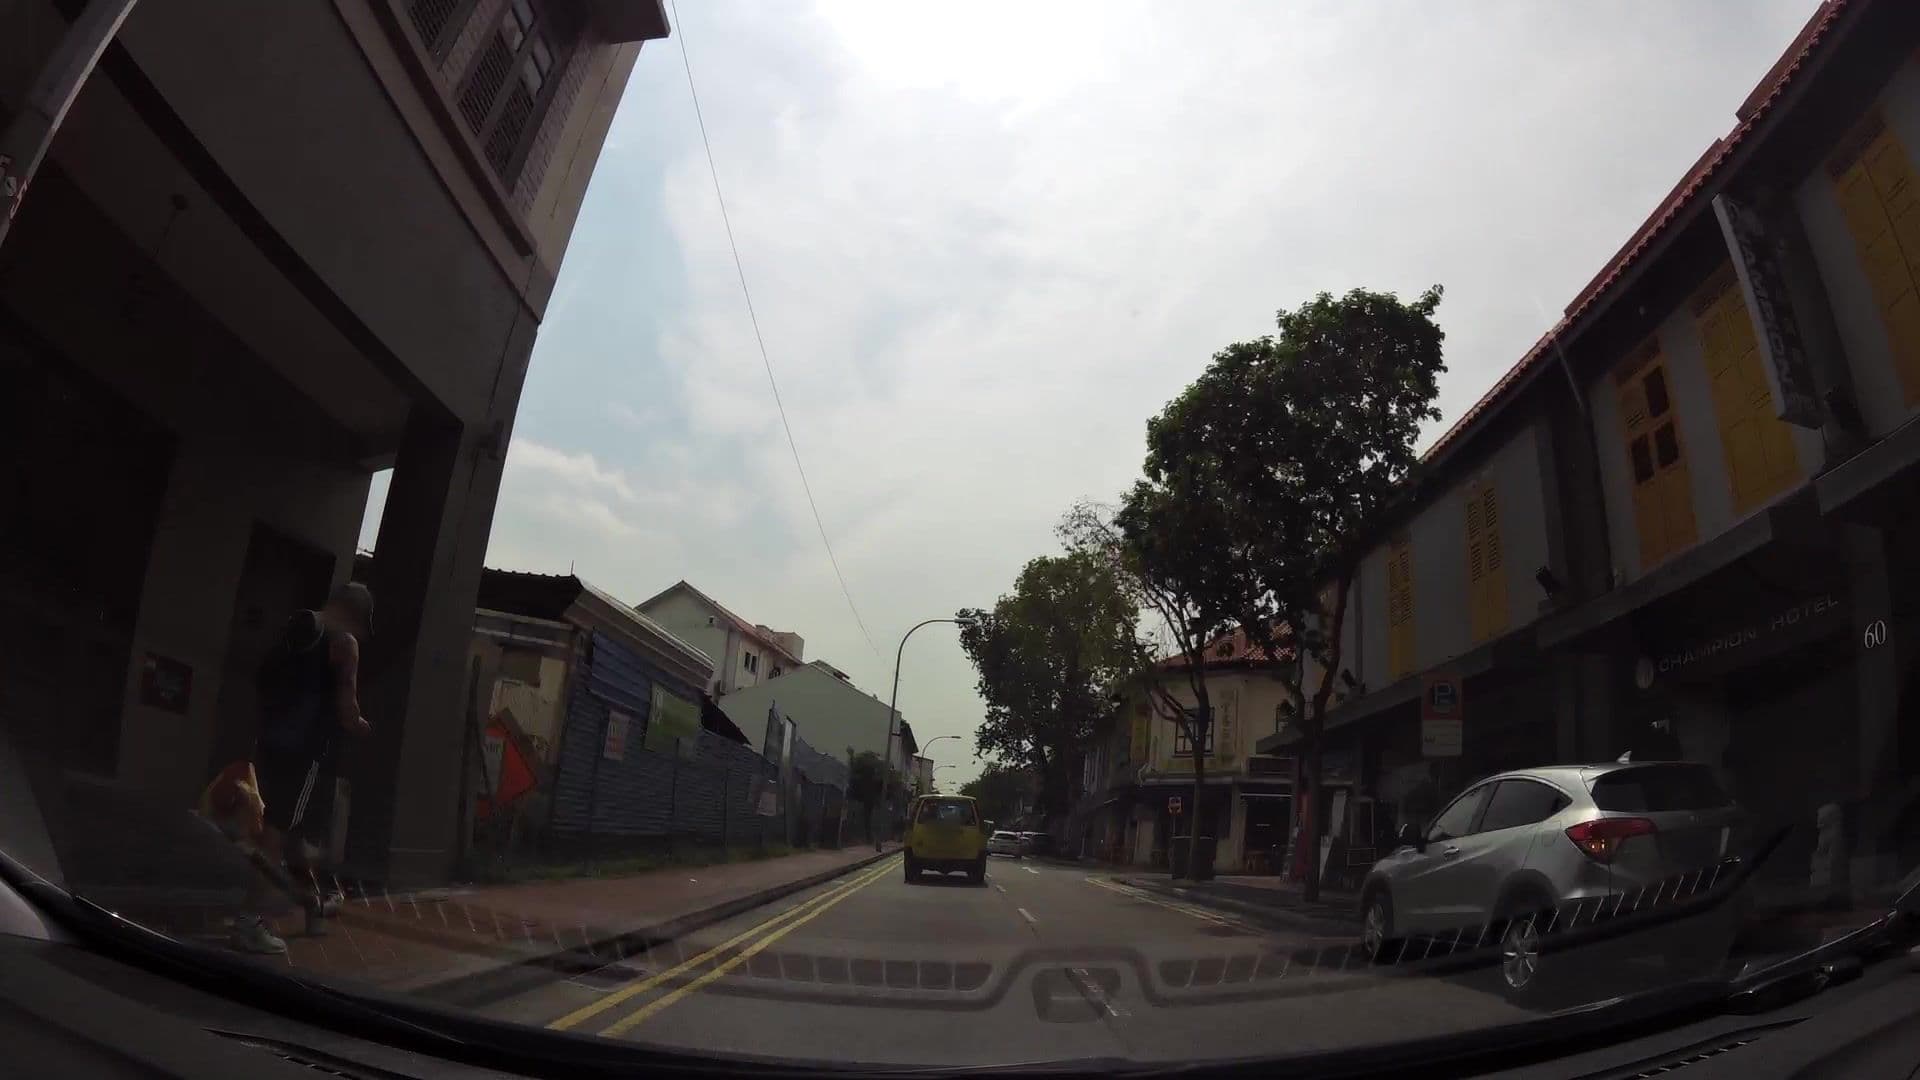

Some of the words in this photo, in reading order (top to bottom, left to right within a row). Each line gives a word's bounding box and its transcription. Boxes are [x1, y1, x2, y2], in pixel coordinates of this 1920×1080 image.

[1656, 624, 1761, 673] CHAMPION
[1769, 592, 1841, 632] HOTEL
[1864, 619, 1888, 649] 60
[1433, 681, 1453, 705] P
